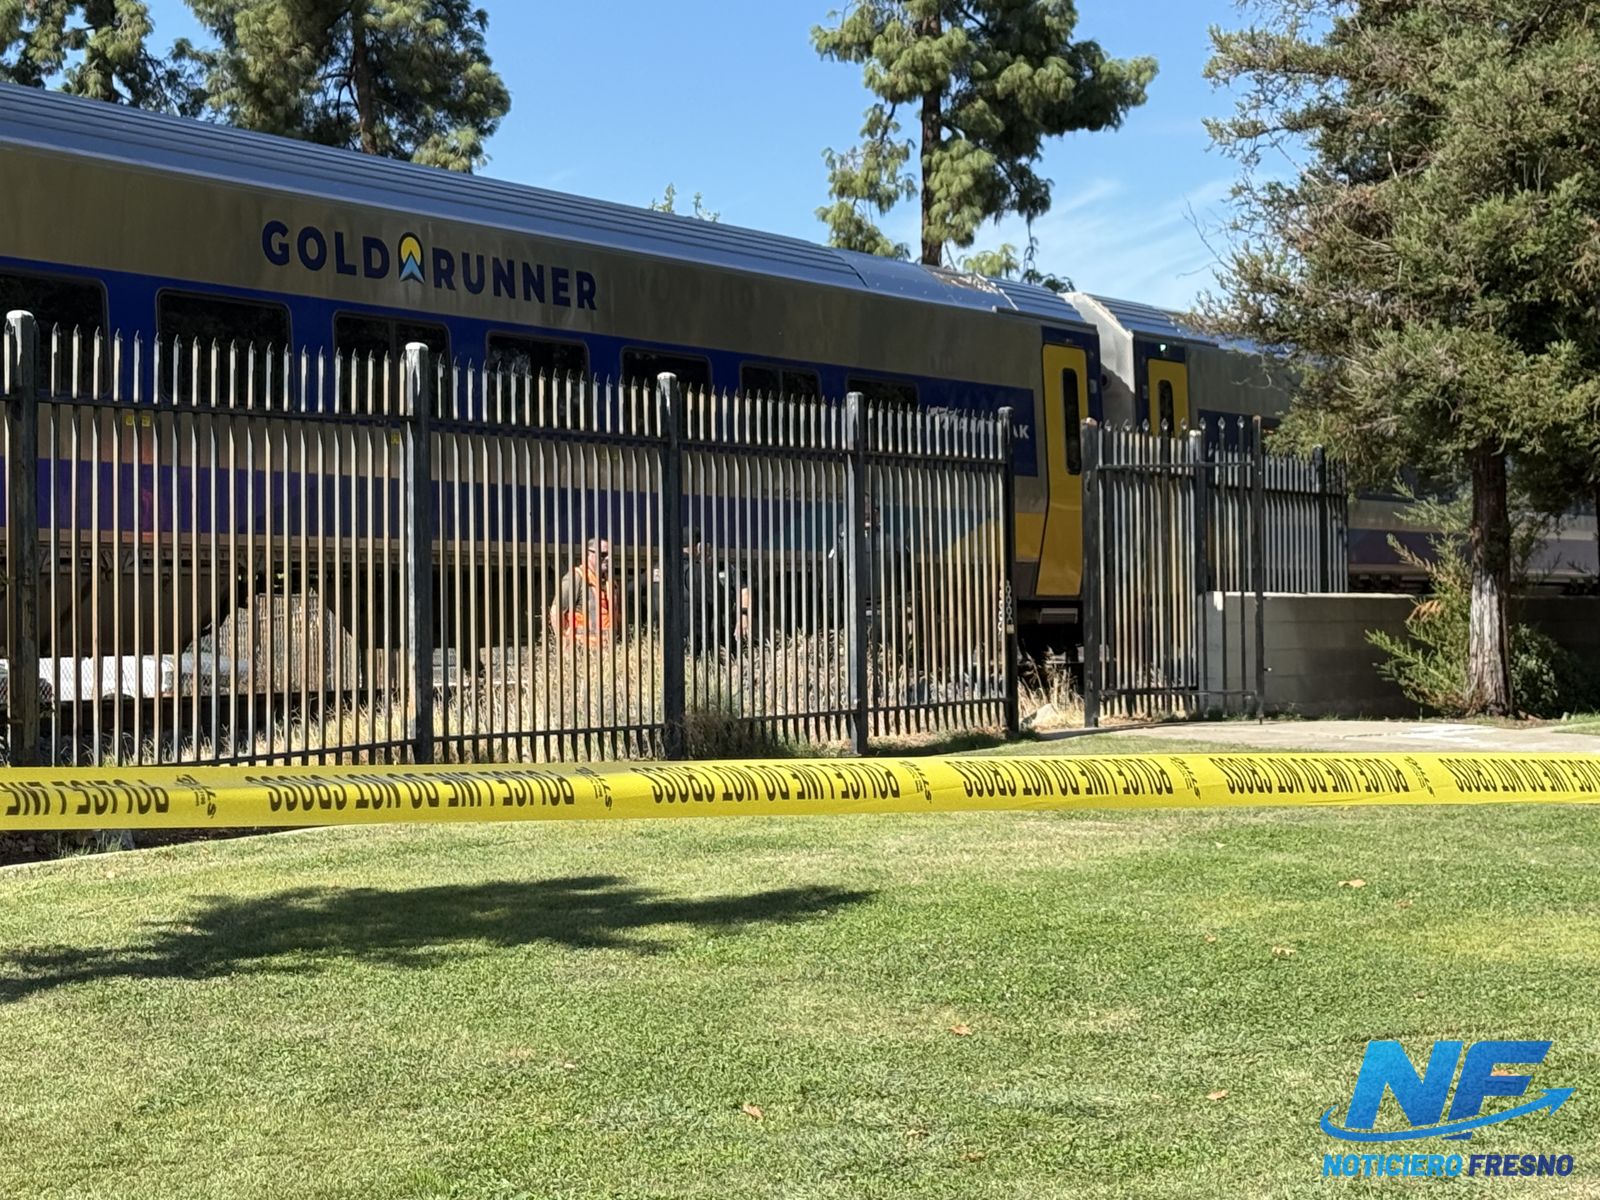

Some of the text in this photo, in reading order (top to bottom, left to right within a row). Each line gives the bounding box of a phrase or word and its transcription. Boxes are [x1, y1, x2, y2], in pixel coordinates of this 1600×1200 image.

[262, 220, 597, 310] GOLD RUNNER
[245, 775, 347, 812] CROSS
[334, 774, 400, 810] NOT
[387, 773, 440, 809] DO
[423, 771, 494, 807] LINE
[478, 770, 575, 807] POLICE
[630, 766, 715, 803] CROSS
[701, 766, 759, 802] NOT
[744, 765, 790, 801] DO
[775, 764, 834, 800] LINE
[819, 763, 900, 800] POLICE
[944, 760, 1016, 797] CROSS
[1004, 760, 1053, 796] NOT
[1040, 760, 1080, 796] DO
[1064, 759, 1118, 796] LINE
[1102, 758, 1173, 795] POLICE
[1209, 758, 1272, 794] CROSS
[1259, 758, 1305, 794] NOT
[1291, 758, 1328, 793] DO
[1311, 758, 1361, 793] LINE
[1345, 758, 1410, 793] POLICE
[1559, 759, 1600, 793] LICE
[51, 779, 169, 815] POLICE
